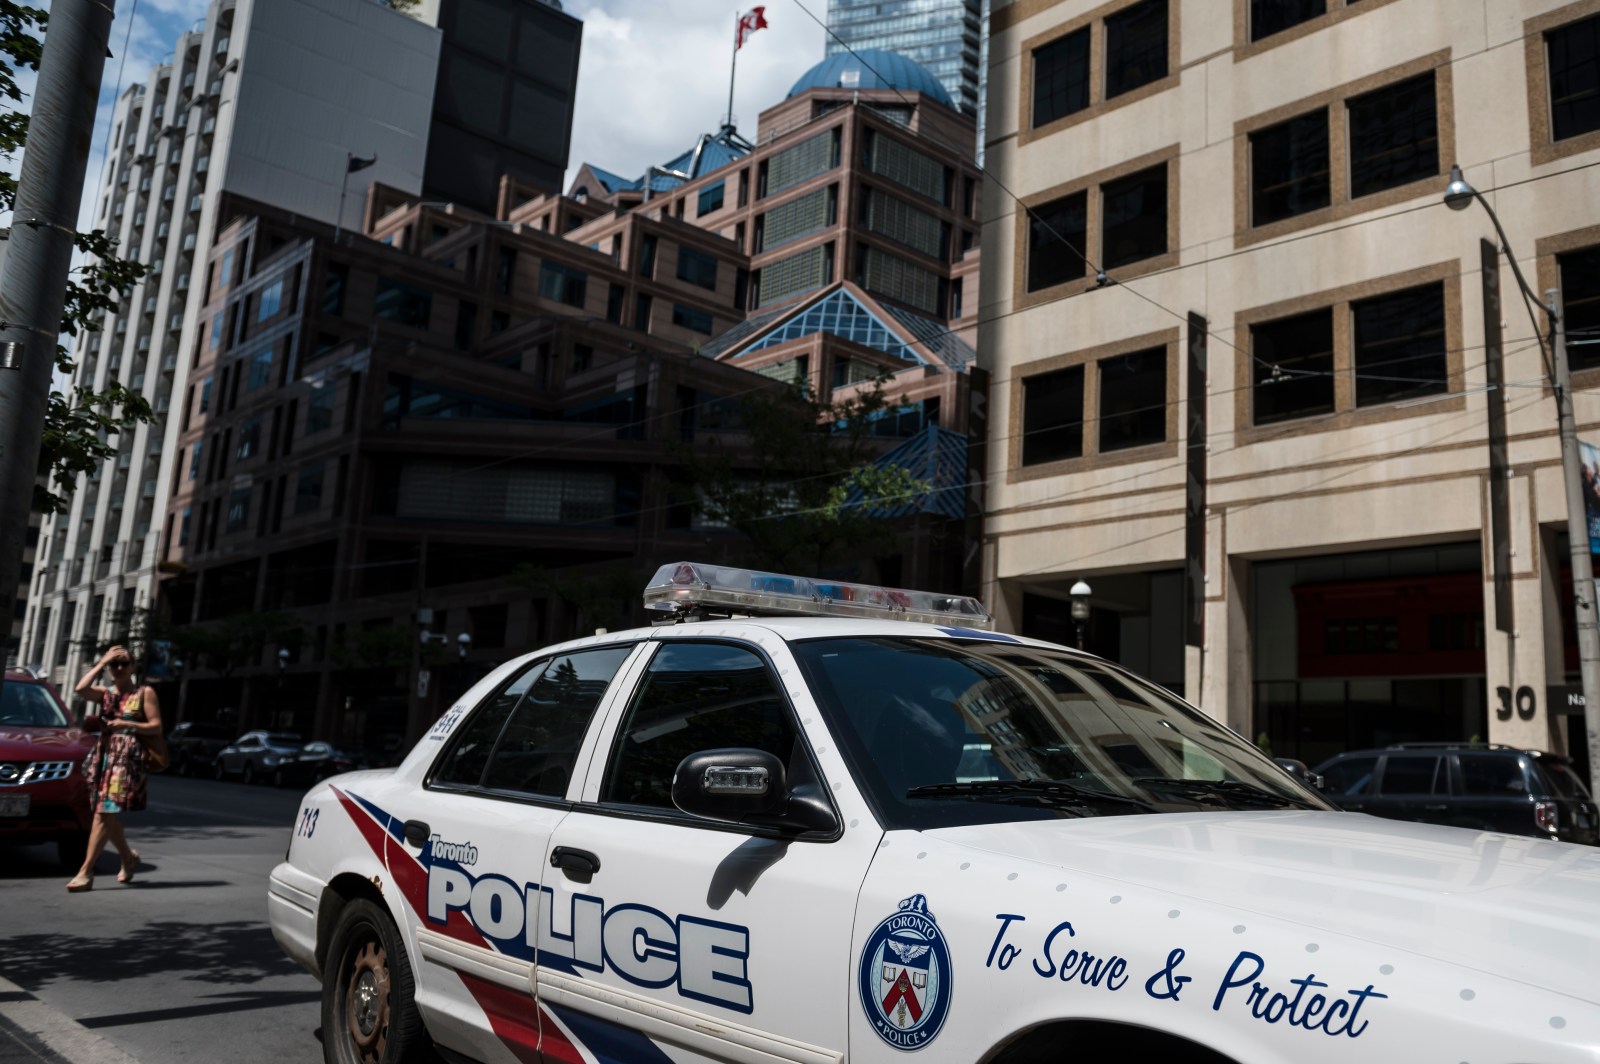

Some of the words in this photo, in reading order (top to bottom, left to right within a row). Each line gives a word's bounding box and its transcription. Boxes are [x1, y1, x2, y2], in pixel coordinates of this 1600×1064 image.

[298, 808, 319, 839] 713
[431, 834, 479, 866] Toronto
[427, 863, 753, 1014] POLICE
[886, 915, 936, 940] TORONTO
[985, 913, 1026, 970] To
[1033, 921, 1130, 991] Serve
[1145, 947, 1192, 1001] &
[1212, 950, 1388, 1038] Protect
[882, 1024, 920, 1046] POLICE
